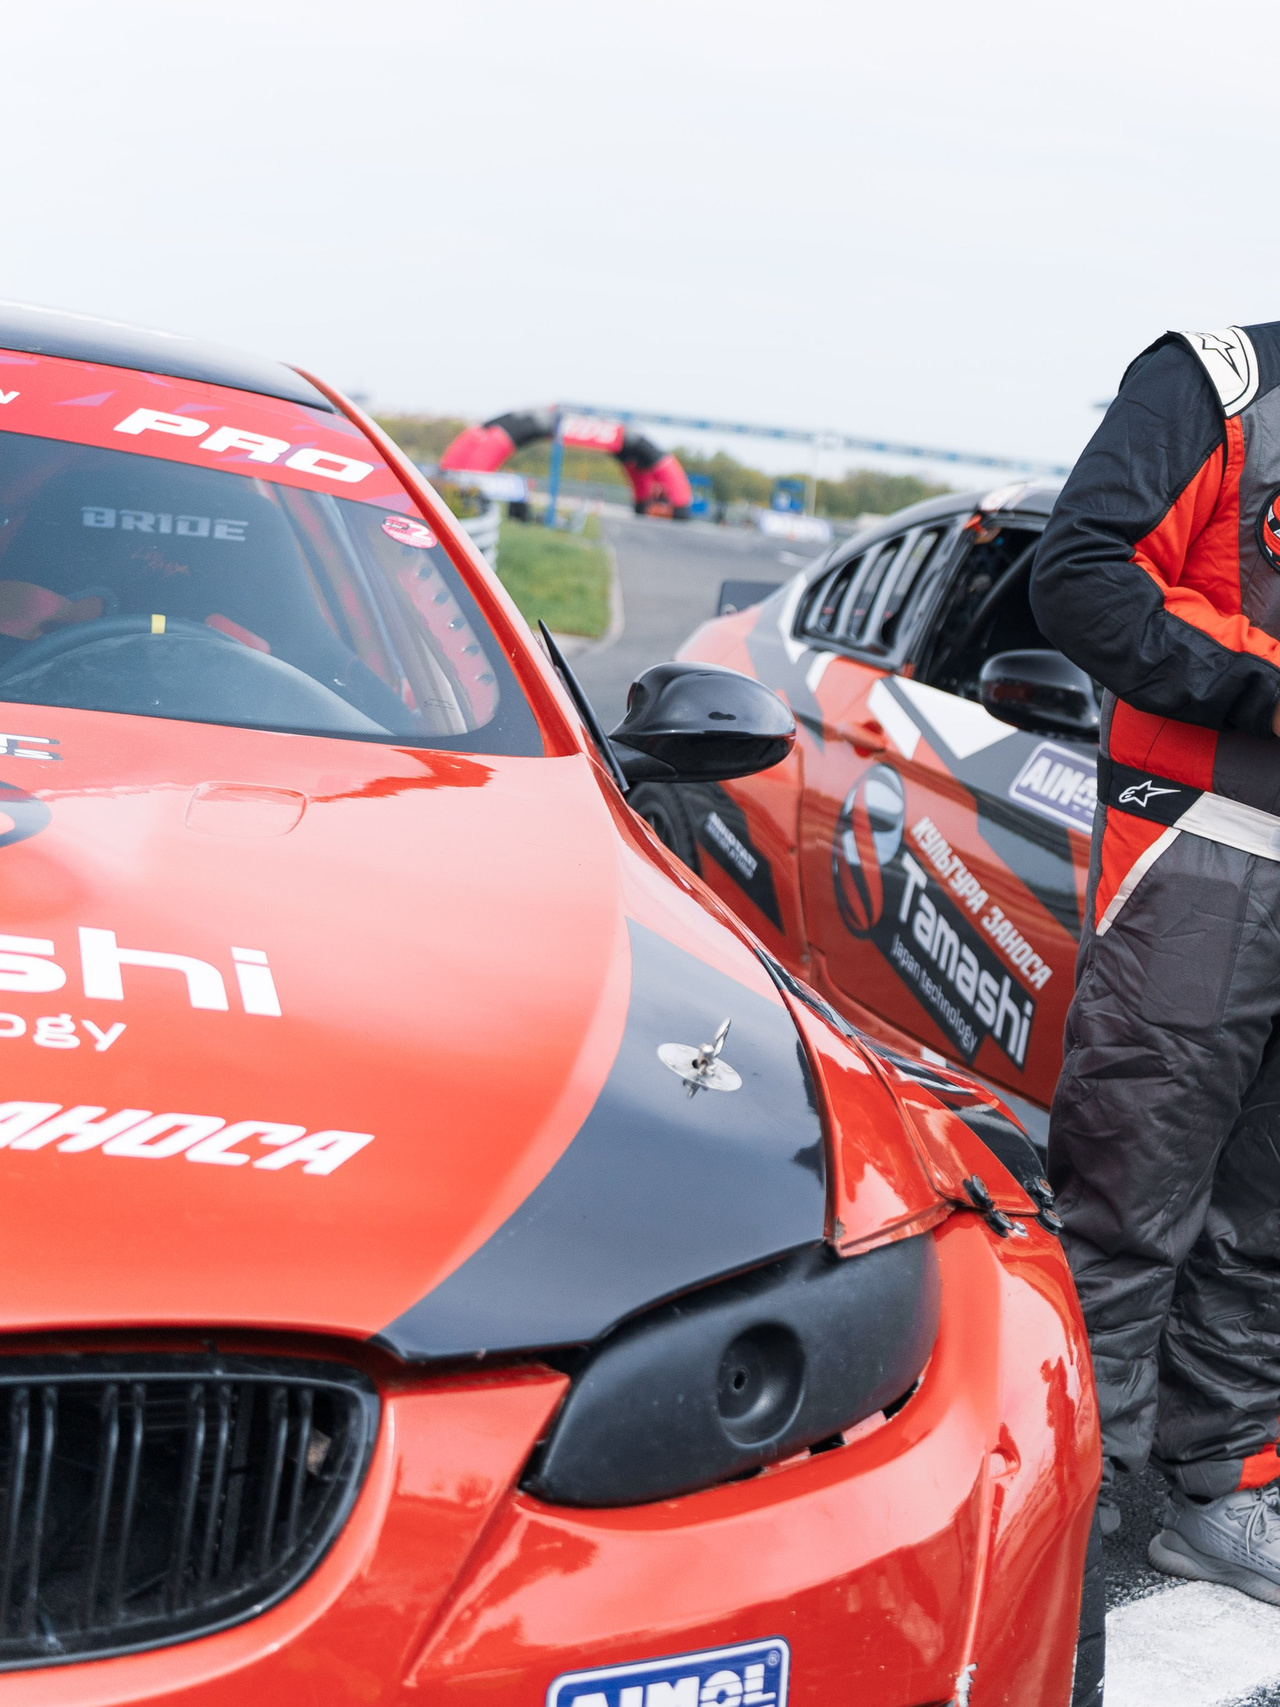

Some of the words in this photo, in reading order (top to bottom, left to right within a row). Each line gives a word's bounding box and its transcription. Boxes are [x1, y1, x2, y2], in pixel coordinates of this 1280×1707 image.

[113, 408, 374, 483] PRO
[81, 507, 248, 541] BRIDE
[1020, 756, 1097, 818] AIMO
[910, 816, 990, 914] КУЛЬТУРА
[981, 904, 1053, 989] ЗАНОСА
[901, 851, 1034, 1066] Tamashi
[919, 967, 979, 1055] technology
[0, 1101, 375, 1175] АНОСА
